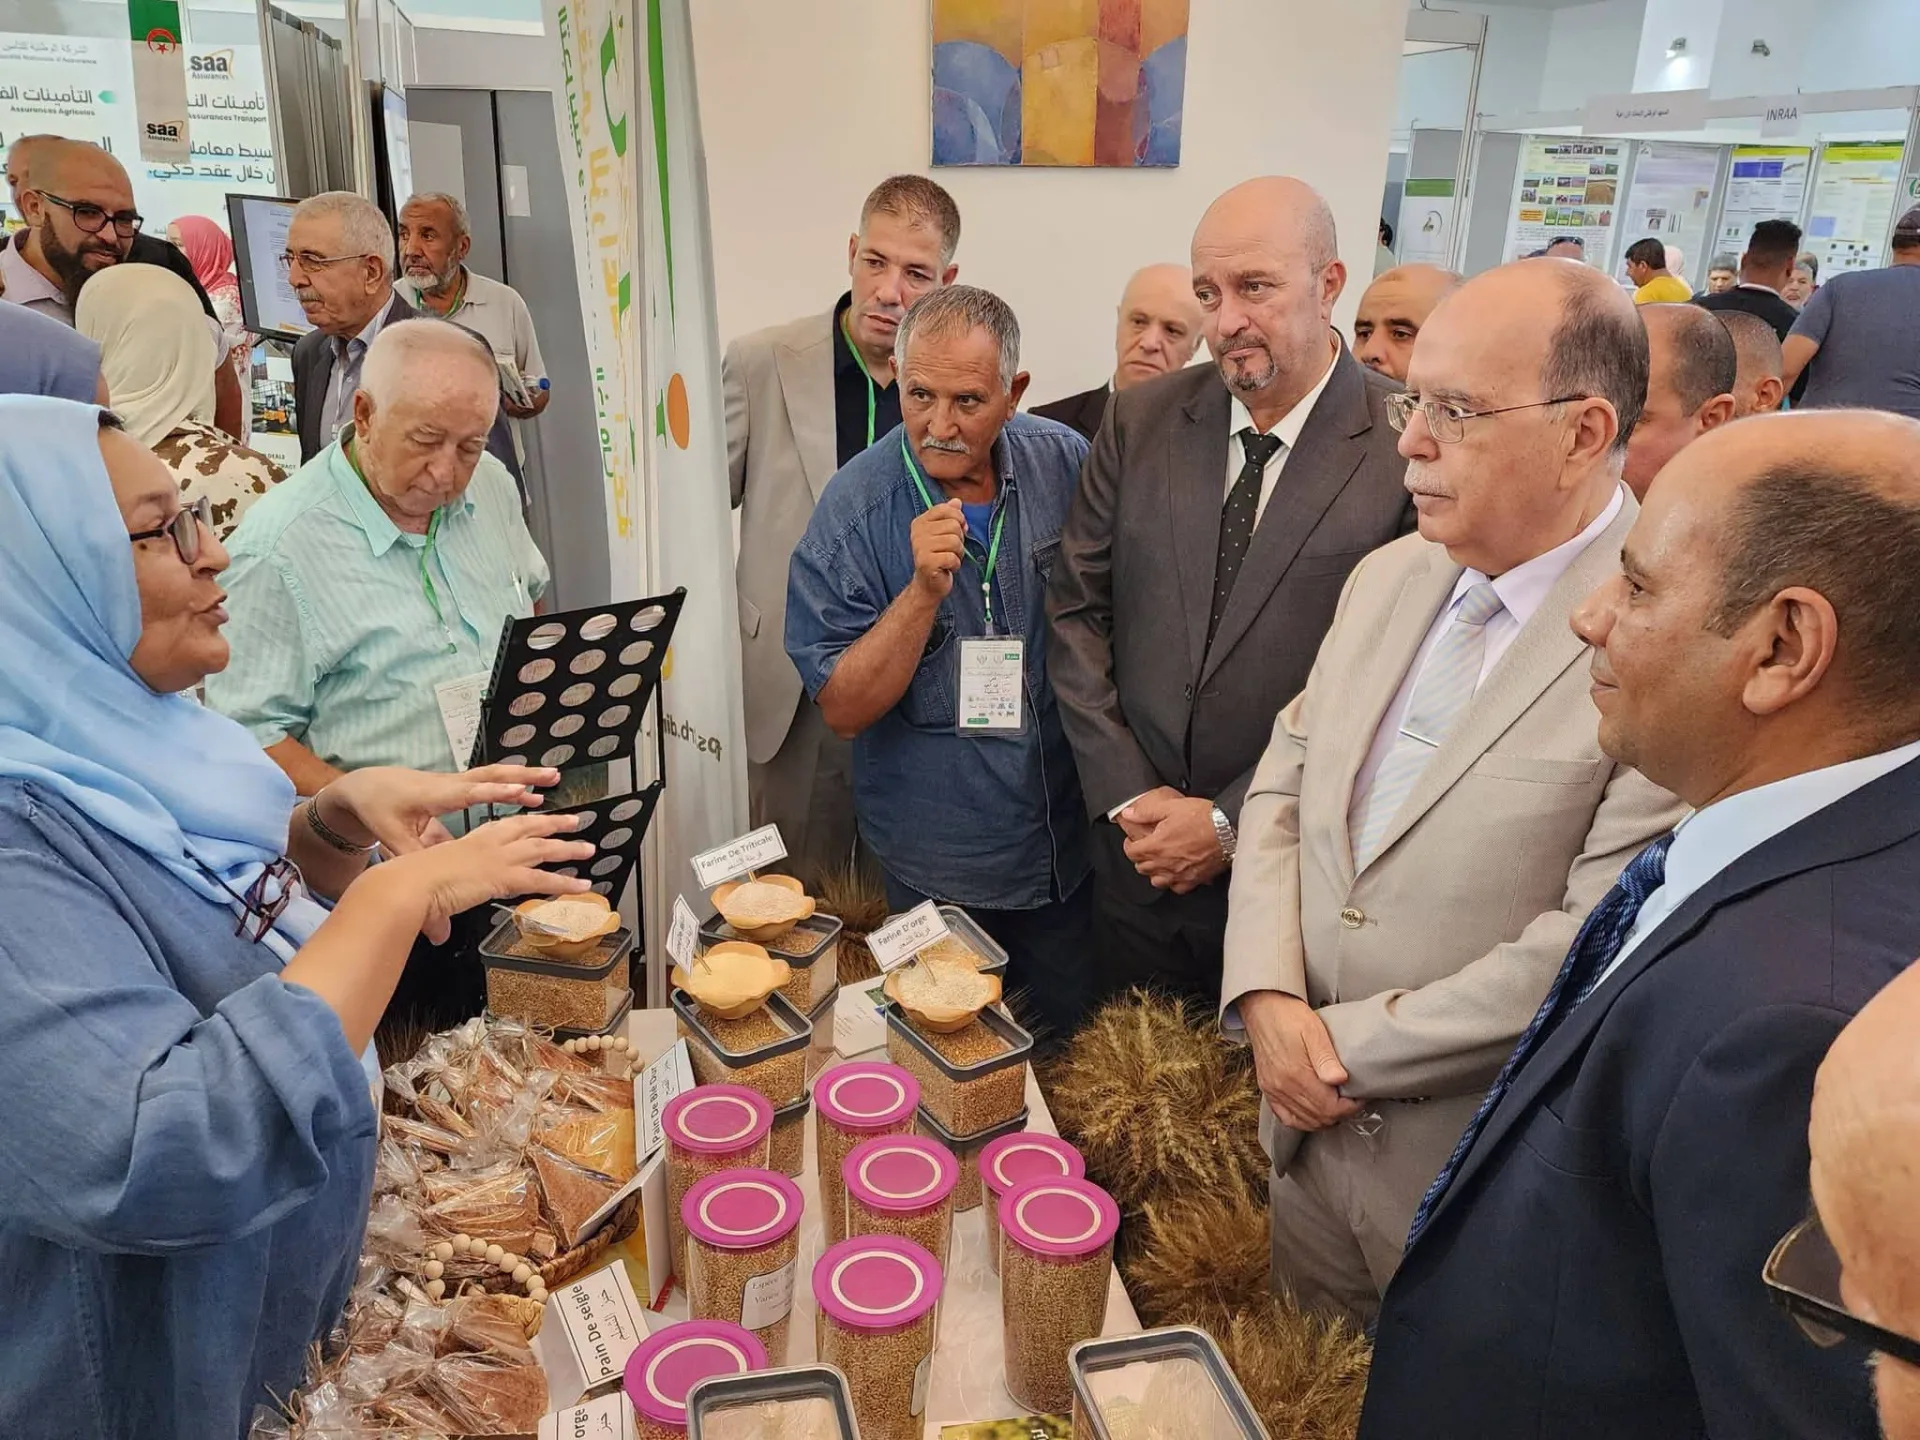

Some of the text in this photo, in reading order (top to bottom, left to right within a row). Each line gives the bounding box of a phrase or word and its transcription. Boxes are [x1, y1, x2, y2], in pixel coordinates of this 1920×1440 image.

[190, 55, 229, 72] saa
[191, 72, 230, 80] Assurances
[23, 85, 93, 106] التأمينات
[10, 106, 96, 117] Assurances Agricoles
[233, 114, 267, 124] Transport
[1766, 106, 1798, 122] INRAA
[146, 122, 178, 137] saa
[147, 134, 178, 143] Assurances
[701, 834, 774, 869] Farine De Triticale
[878, 914, 928, 946] Farine D'orge
[649, 1066, 658, 1085] Dur
[650, 1102, 659, 1118] De
[651, 1117, 661, 1144] Pain
[597, 1288, 616, 1307] خبز
[571, 1284, 614, 1377] Pain De seigle
